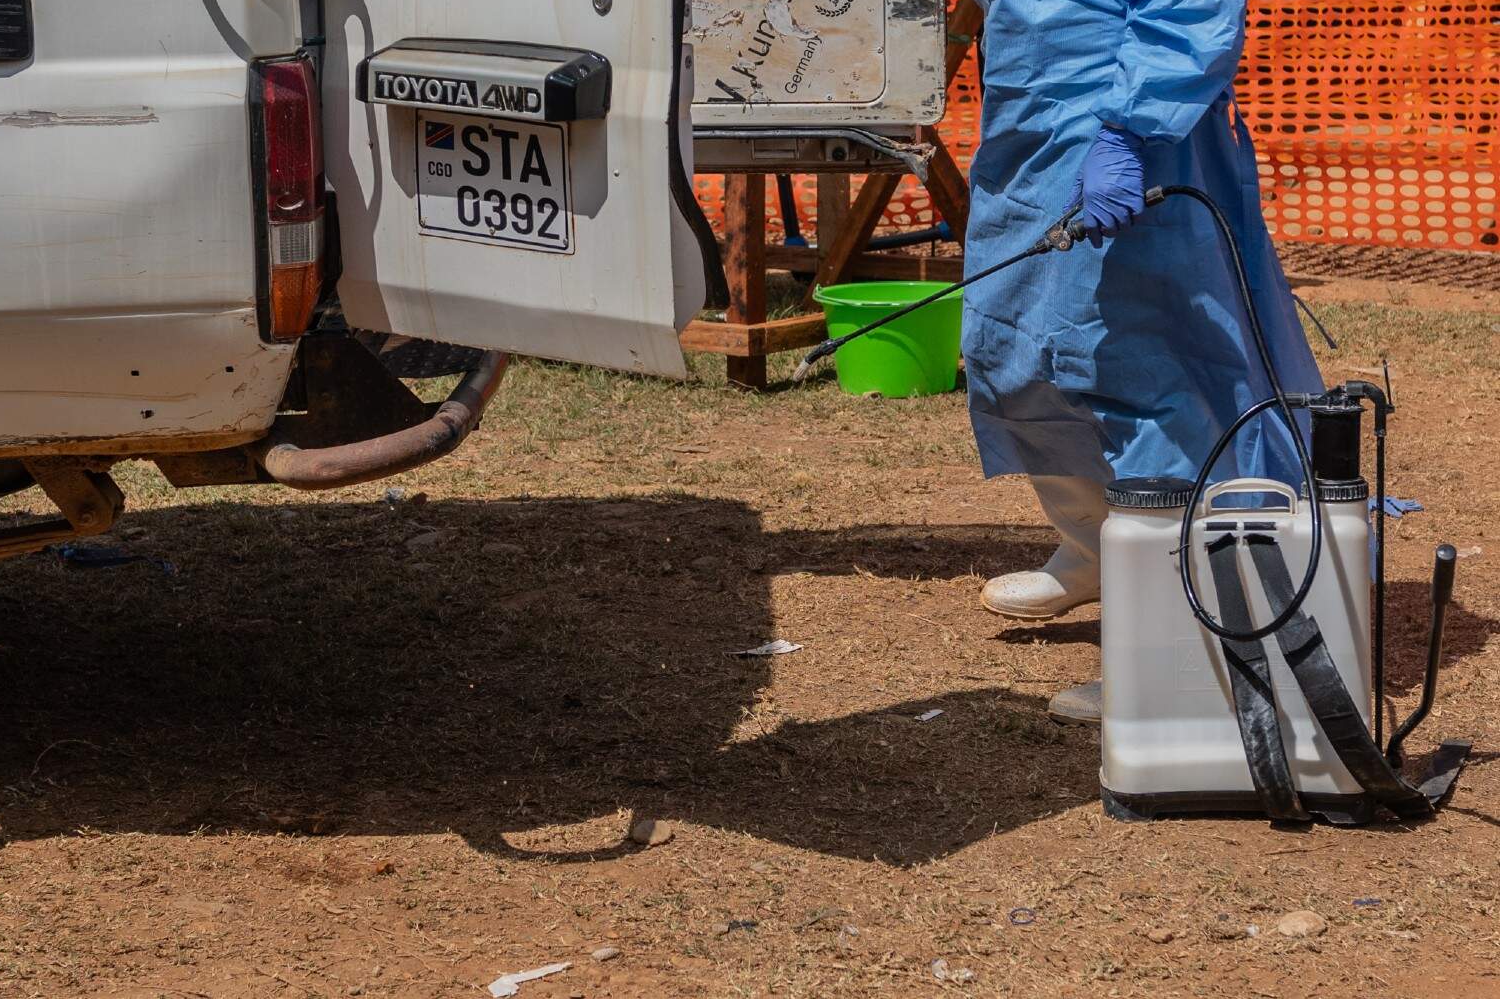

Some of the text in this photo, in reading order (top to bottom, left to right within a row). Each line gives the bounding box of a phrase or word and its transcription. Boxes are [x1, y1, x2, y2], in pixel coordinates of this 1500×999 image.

[784, 35, 823, 94] Germany
[378, 73, 542, 114] TOYOTA 4WD
[427, 160, 453, 178] CGO
[460, 124, 552, 187] STA
[456, 185, 560, 240] 0392
